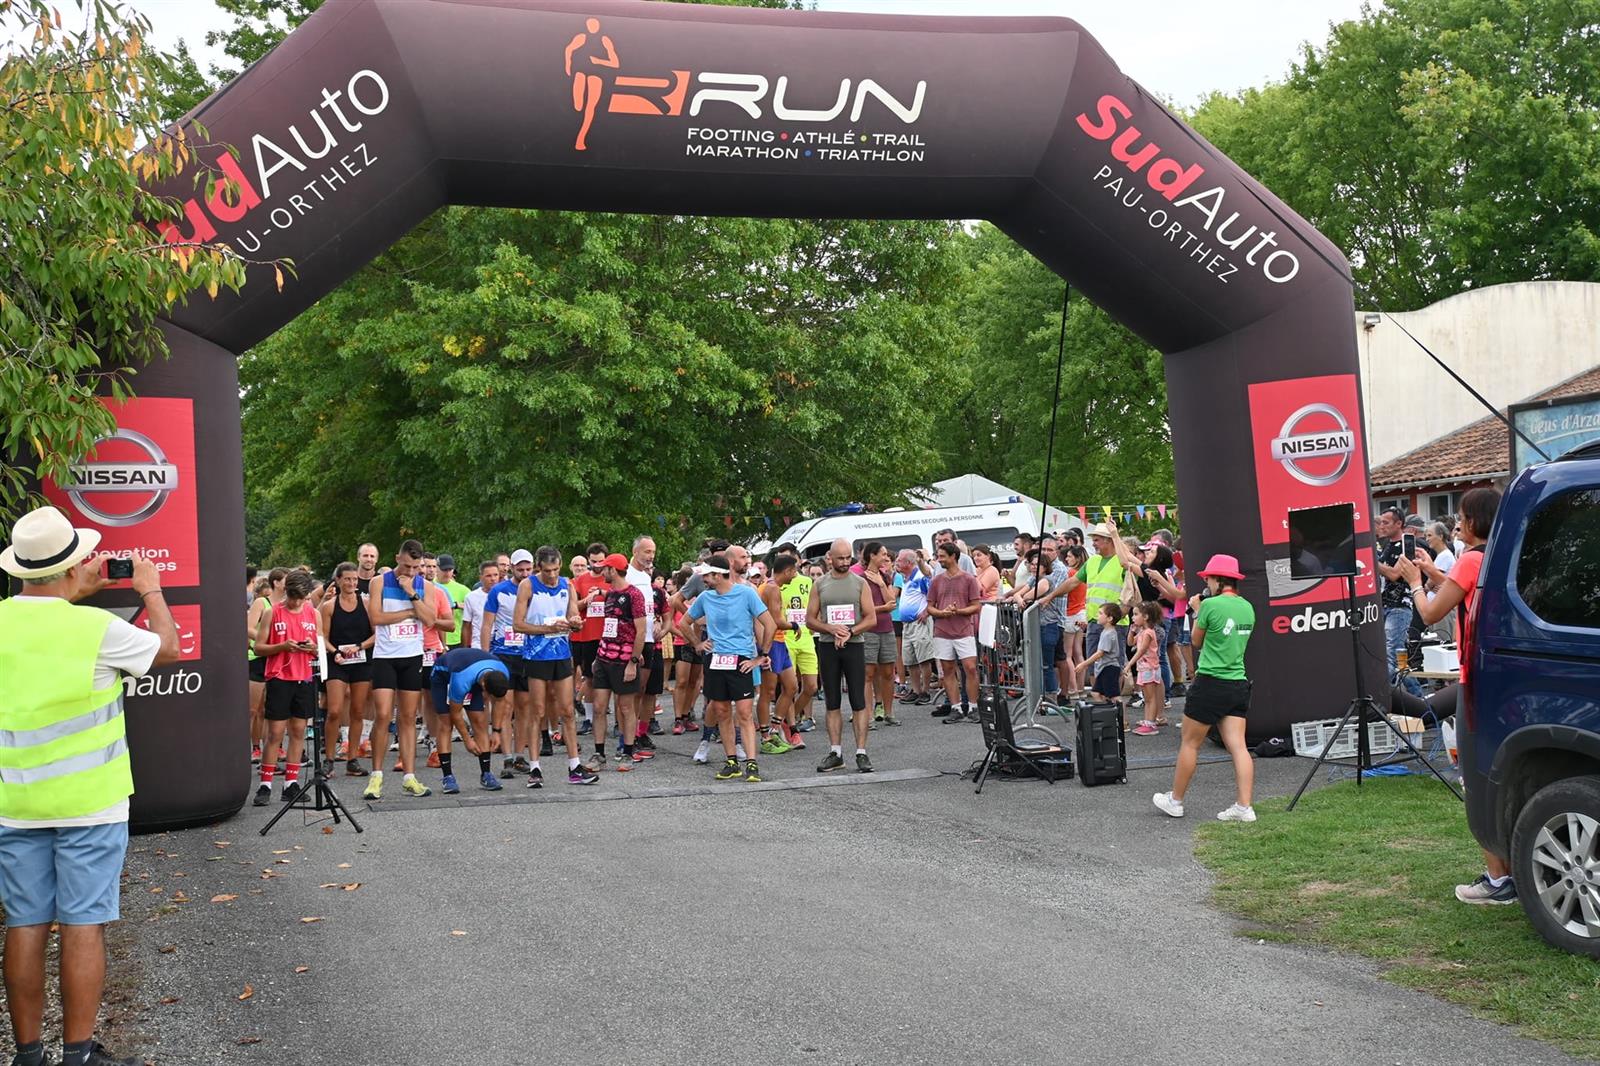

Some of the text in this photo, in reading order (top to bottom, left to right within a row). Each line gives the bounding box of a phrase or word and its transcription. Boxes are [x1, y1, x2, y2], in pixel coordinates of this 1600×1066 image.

[687, 128, 926, 146] FOOTING ATHLÉ TRAIL
[686, 144, 925, 162] MARATHON TRIATHLON
[156, 70, 389, 257] udAuto
[236, 143, 378, 252] U-ORTHEZ
[1075, 94, 1300, 283] SudAuto
[1093, 165, 1239, 283] PAU-ORTHEZ
[1281, 435, 1349, 455] NISSAN
[71, 470, 166, 485] NISSAN
[891, 519, 920, 527] PREMIERS
[921, 517, 948, 525] SECOURS
[953, 514, 984, 522] PERSONNE
[831, 611, 851, 620] 142
[396, 625, 415, 635] 130
[121, 668, 202, 697] nauto
